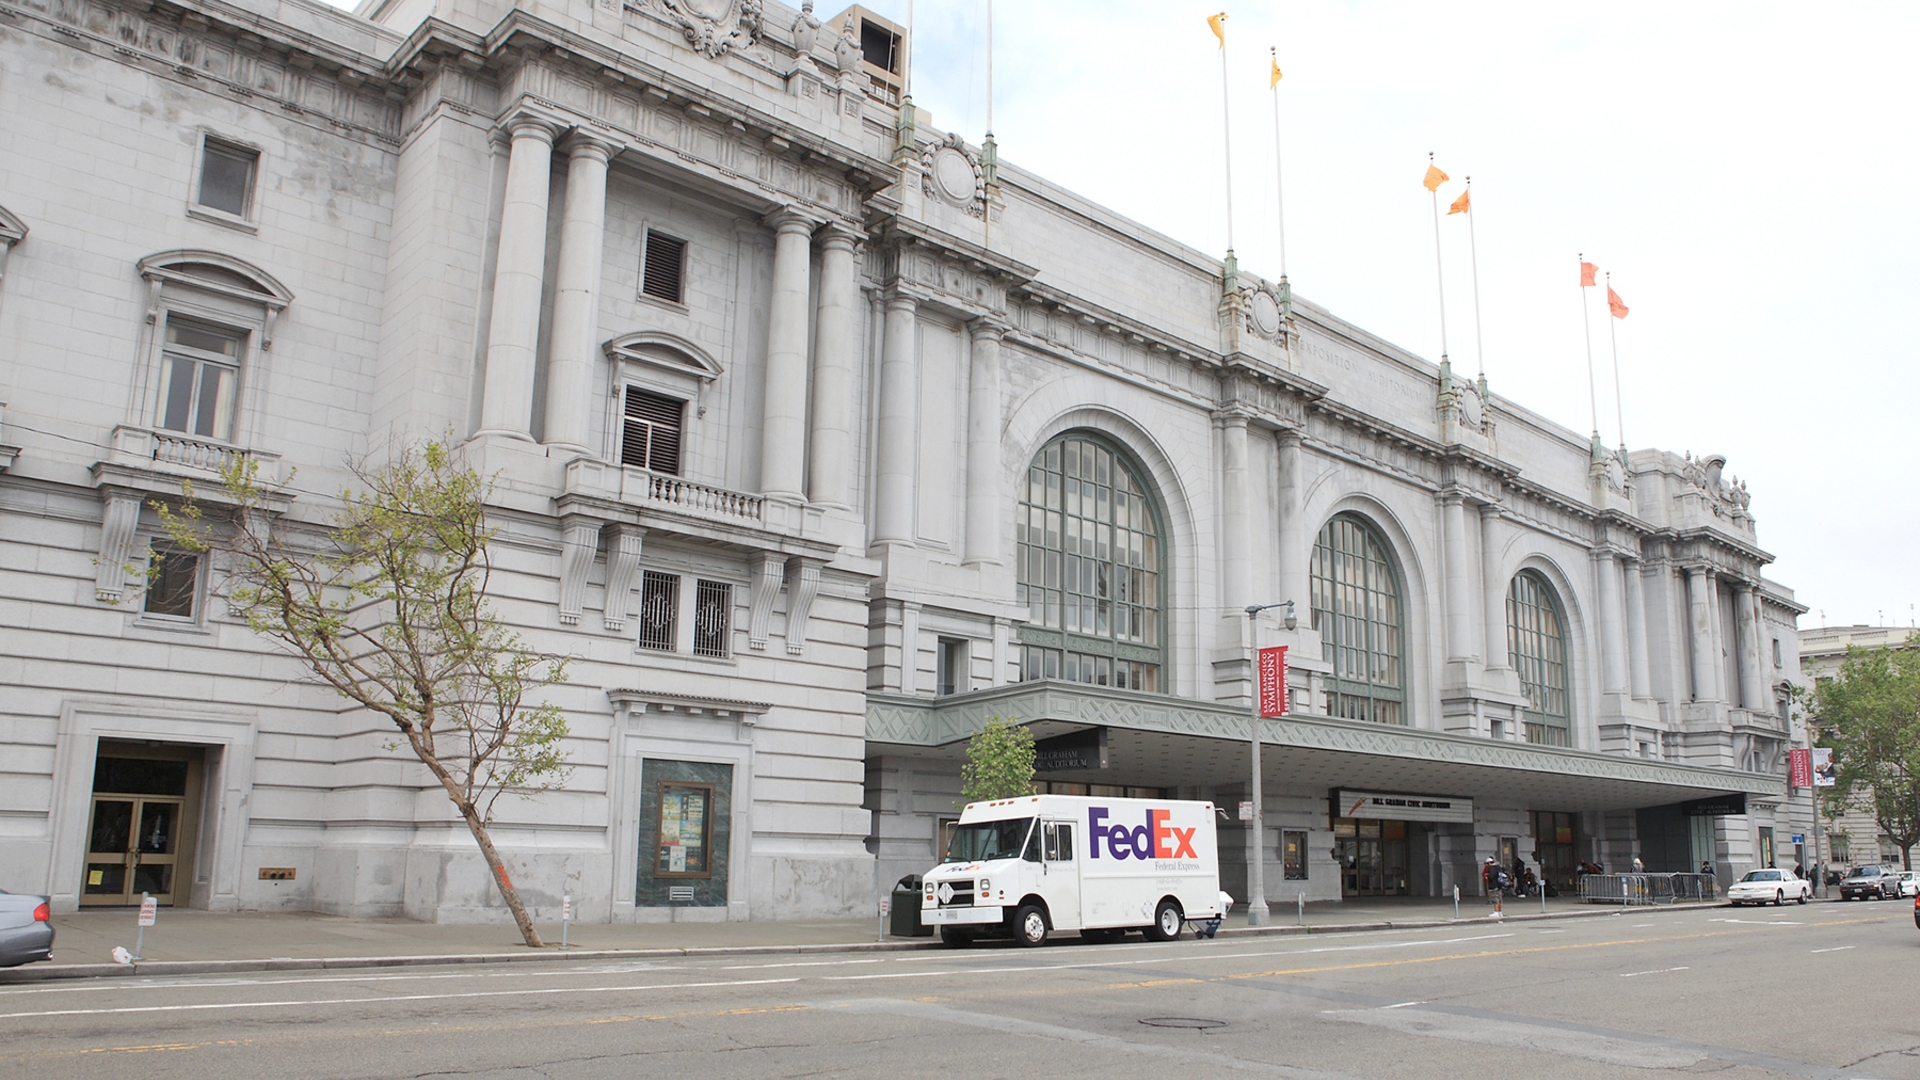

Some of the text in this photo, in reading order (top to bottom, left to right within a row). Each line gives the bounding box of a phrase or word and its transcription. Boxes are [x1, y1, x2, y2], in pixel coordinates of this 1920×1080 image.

[1300, 340, 1422, 401] EXPOSITION AUDITORIUM
[1267, 652, 1276, 713] SYMPHONY
[1048, 750, 1078, 759] GRAHAM
[1047, 759, 1088, 768] AUDITORIUM
[1373, 797, 1451, 809] BILL GRAHAM CIVIC AUDITORIUM
[1088, 807, 1198, 860] FedEx
[1155, 861, 1200, 872] Federal Express
